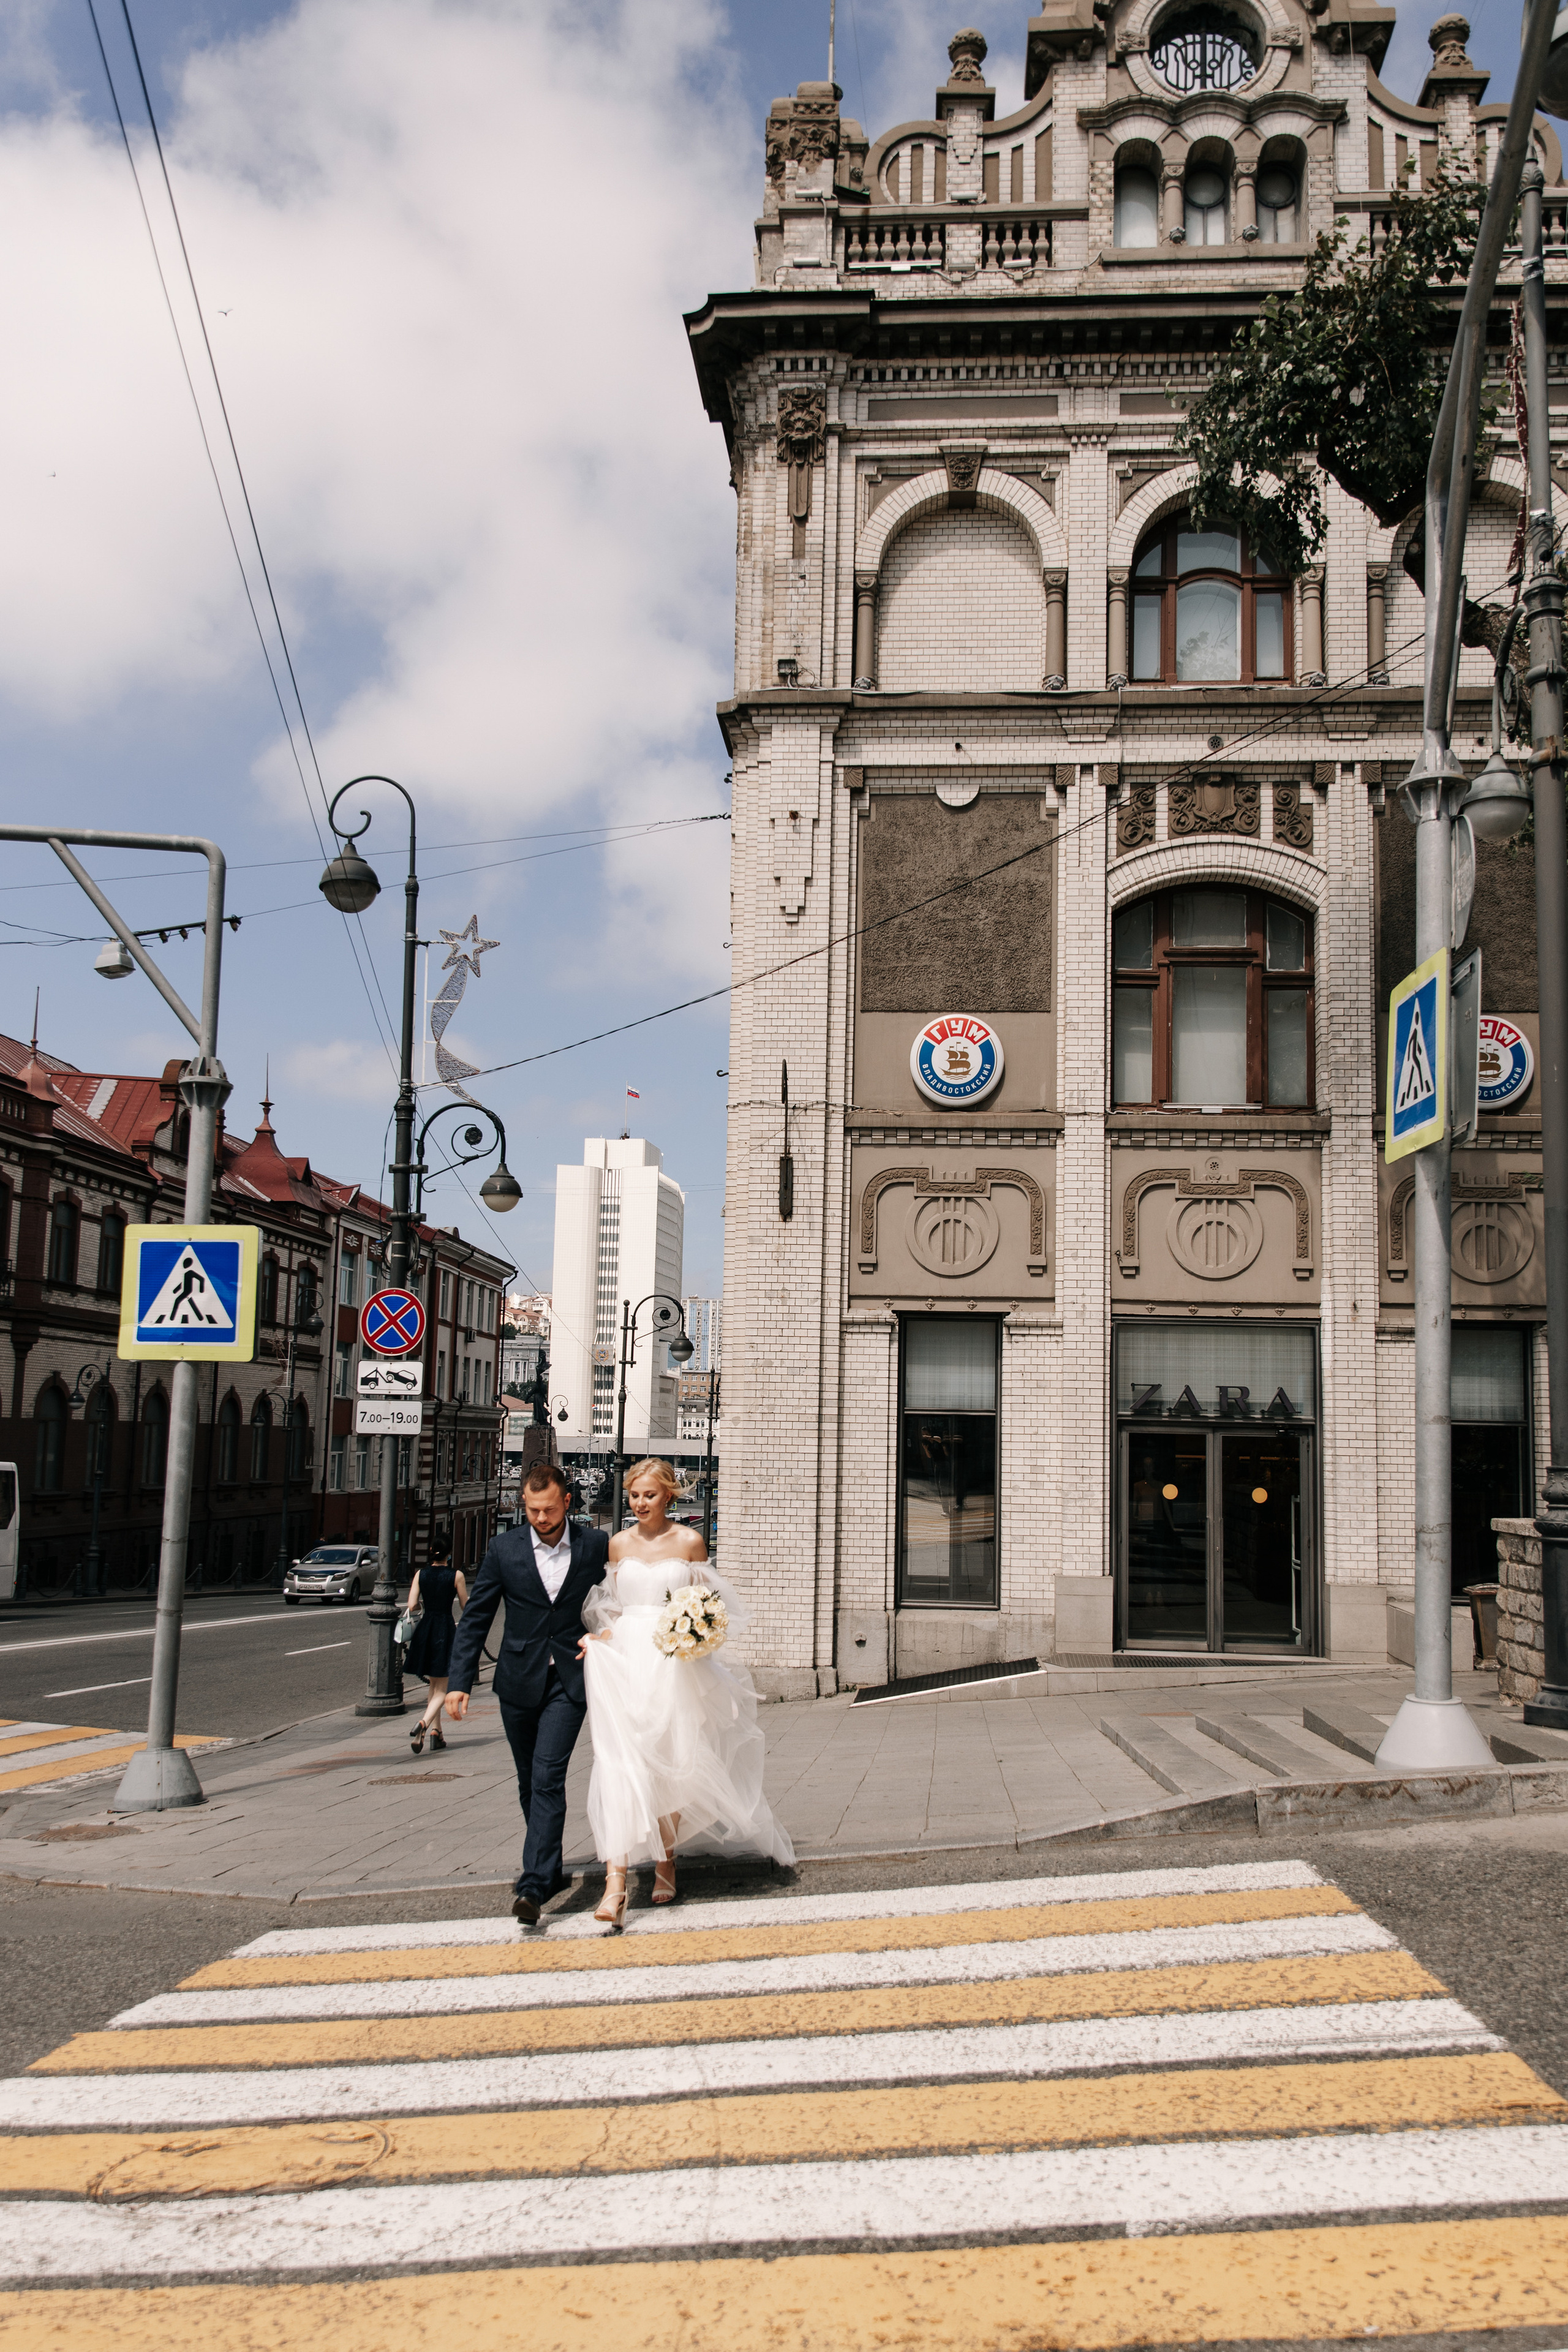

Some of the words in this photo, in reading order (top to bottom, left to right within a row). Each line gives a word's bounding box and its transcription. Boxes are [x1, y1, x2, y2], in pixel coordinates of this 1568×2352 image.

[930, 1020, 986, 1041] ГУМ
[1480, 1022, 1517, 1045] УМ
[922, 1063, 991, 1094] ВЛАДИВОСТОКСКИЙ
[1478, 1067, 1522, 1097] ОСТОКСКИЙ
[1129, 1382, 1302, 1414] ZARA
